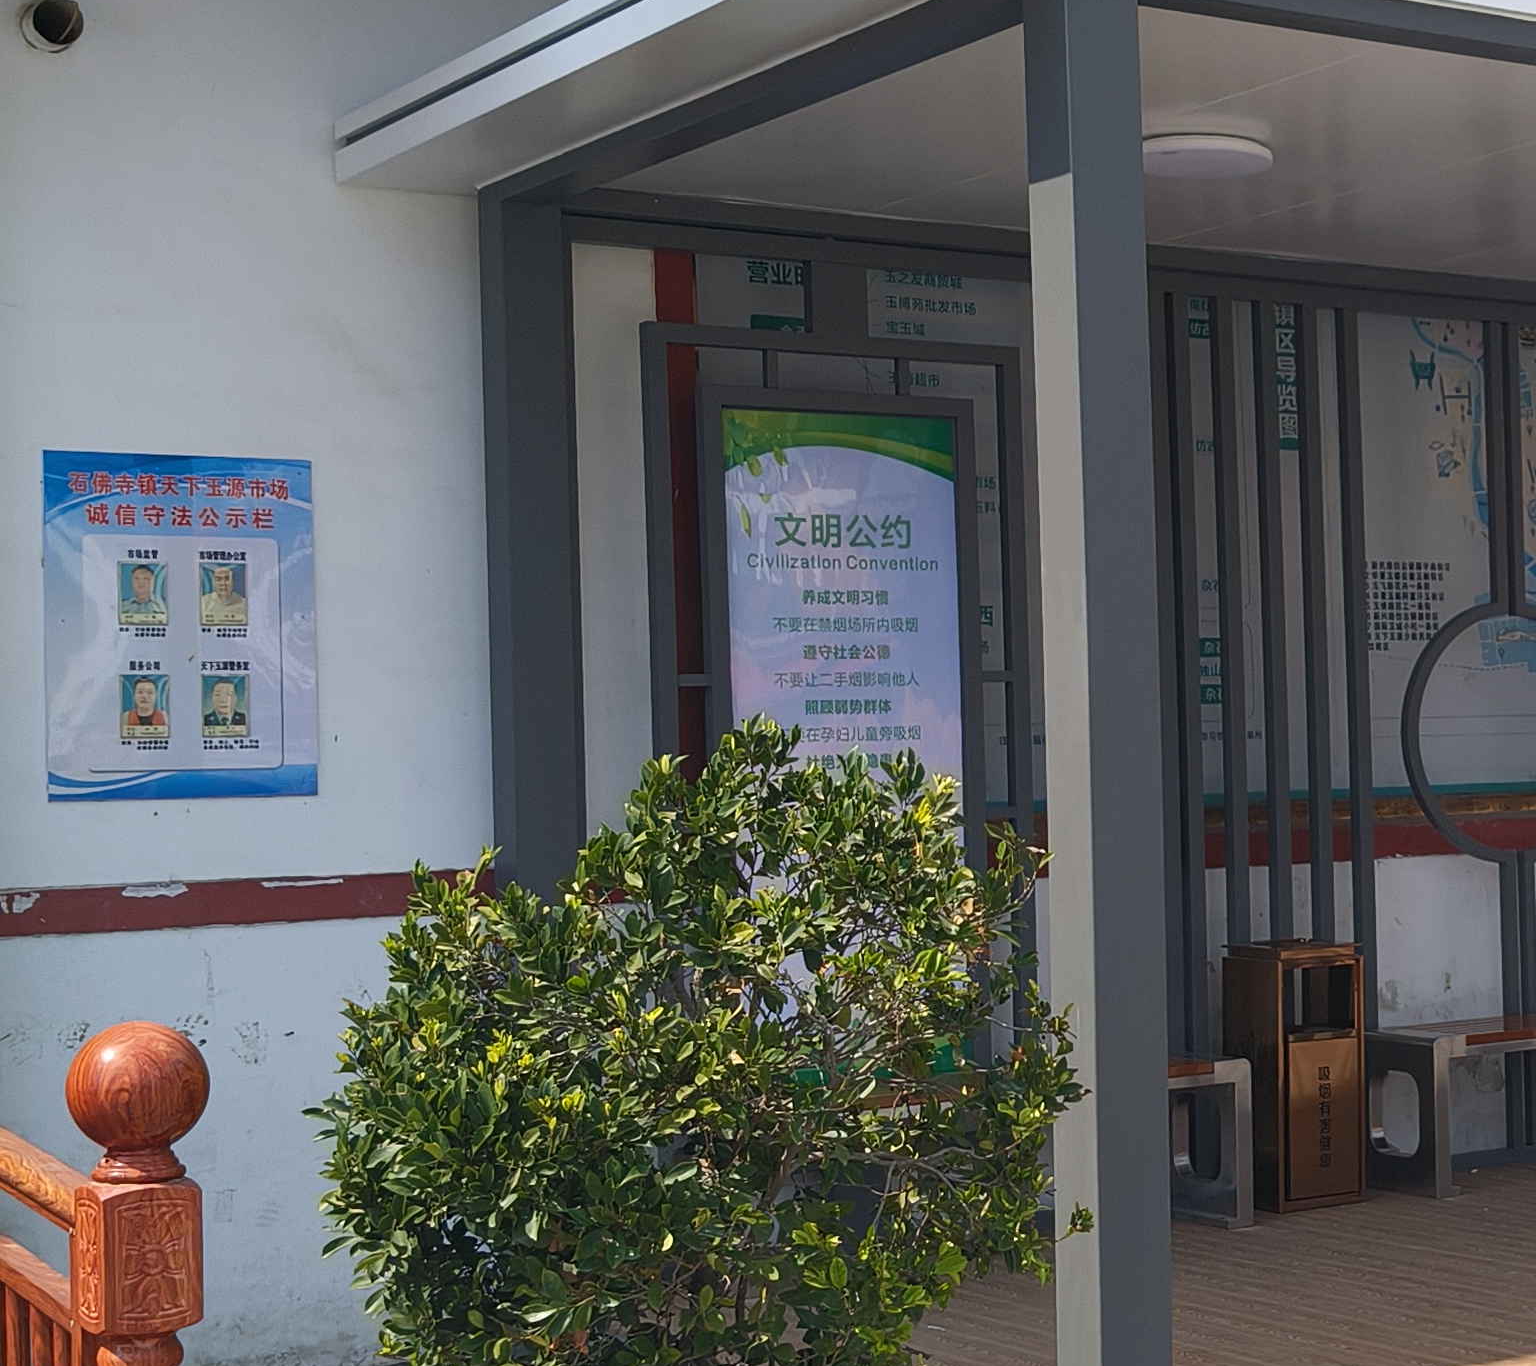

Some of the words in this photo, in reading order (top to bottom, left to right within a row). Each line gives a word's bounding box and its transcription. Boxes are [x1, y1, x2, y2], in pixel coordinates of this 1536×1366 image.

[68, 472, 290, 501] 石佛寺镇天下玉源市场
[86, 503, 275, 529] 诚信守法公示栏
[774, 512, 911, 549] 文明公约
[746, 552, 842, 571] Civilization
[845, 554, 939, 572] Convention
[802, 590, 889, 606] 养成文明习惯
[773, 617, 919, 633] 不要在禁烟场所内吸烟
[803, 644, 890, 660] 遵守社会公德
[774, 672, 920, 689] 不要让二手烟影响他人
[804, 700, 892, 715] 照顾弱势群体
